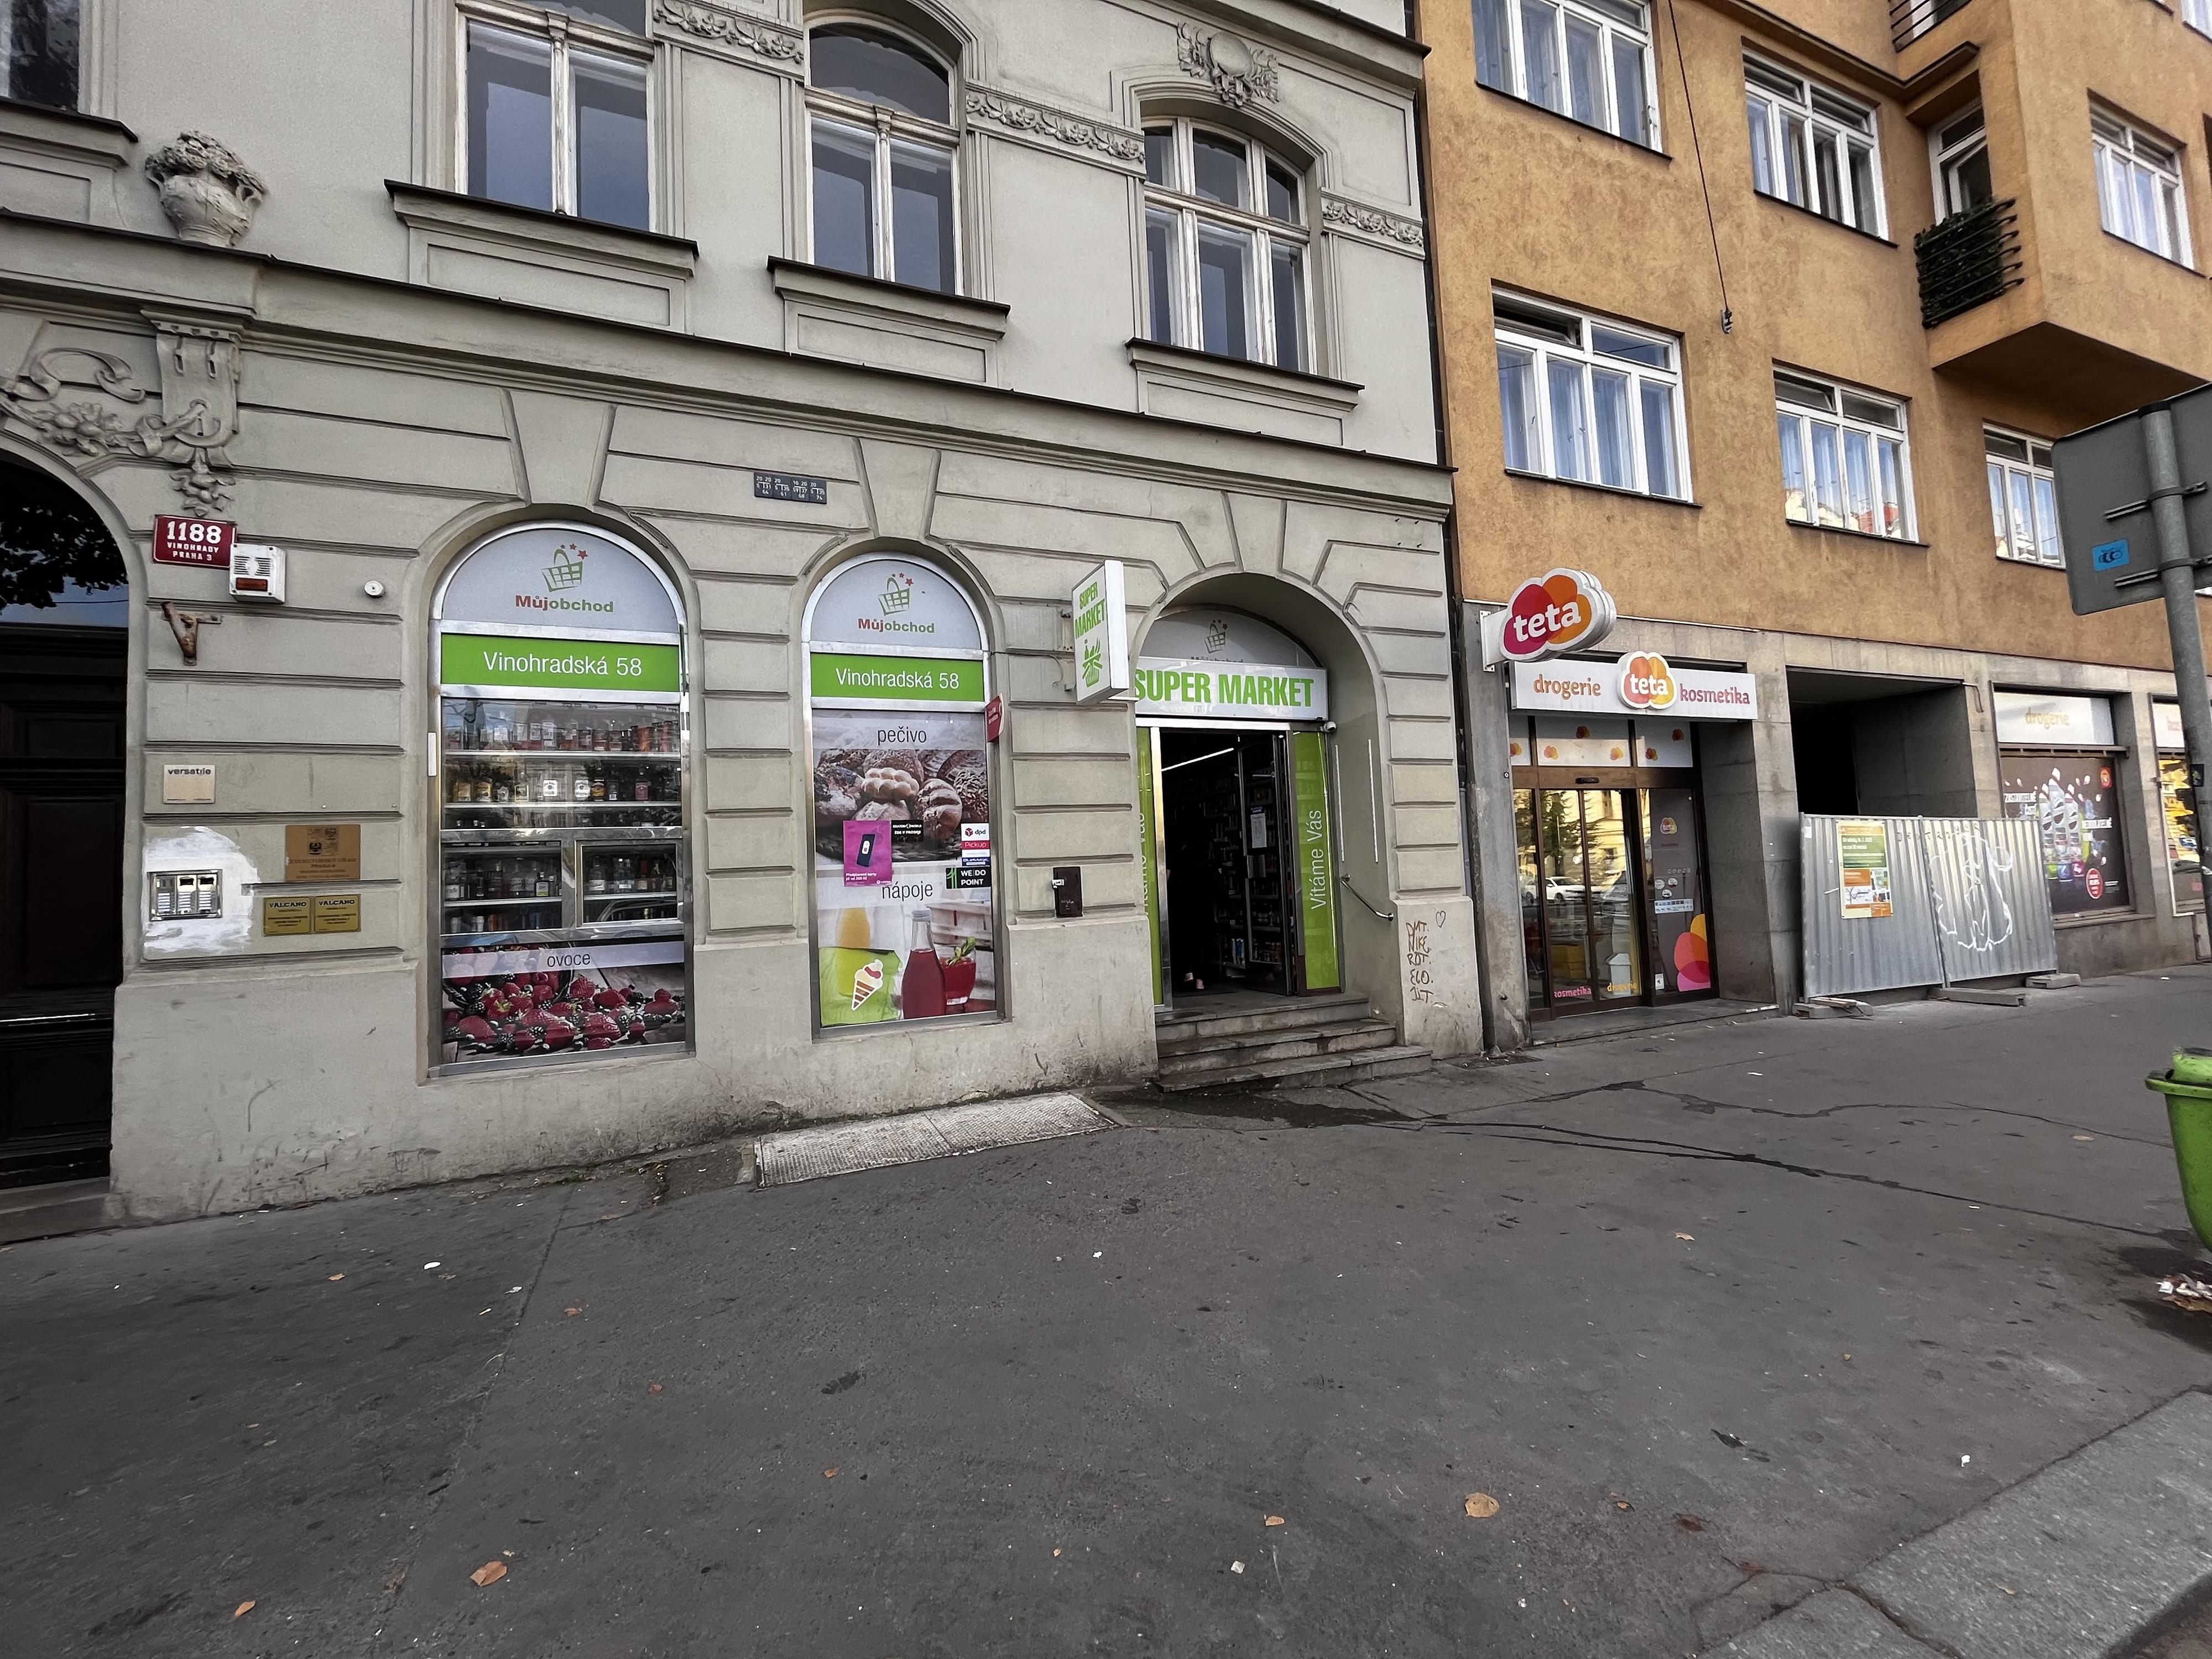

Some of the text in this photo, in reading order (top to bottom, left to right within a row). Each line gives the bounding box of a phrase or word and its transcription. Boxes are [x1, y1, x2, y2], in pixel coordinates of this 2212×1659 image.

[167, 521, 222, 544] 1188
[167, 542, 219, 553] VINOHRADY
[173, 551, 203, 560] PRAHA
[1079, 581, 1098, 610] SUPER
[1074, 598, 1105, 640] MARKET
[1513, 602, 1582, 642] teta
[483, 651, 642, 676] Vinohradská 58
[836, 667, 959, 689] Vinohradská 58
[1134, 669, 1314, 708] SUPER MARKET
[1533, 674, 1601, 700] drogerie
[1630, 673, 1669, 695] teta
[1679, 684, 1750, 705] kosmetika
[2025, 707, 2069, 729] drogerie
[878, 726, 927, 746] pečivo
[1306, 810, 1327, 910] Vítáme Vás
[882, 881, 933, 901] nápoje
[547, 954, 591, 967] ovoce
